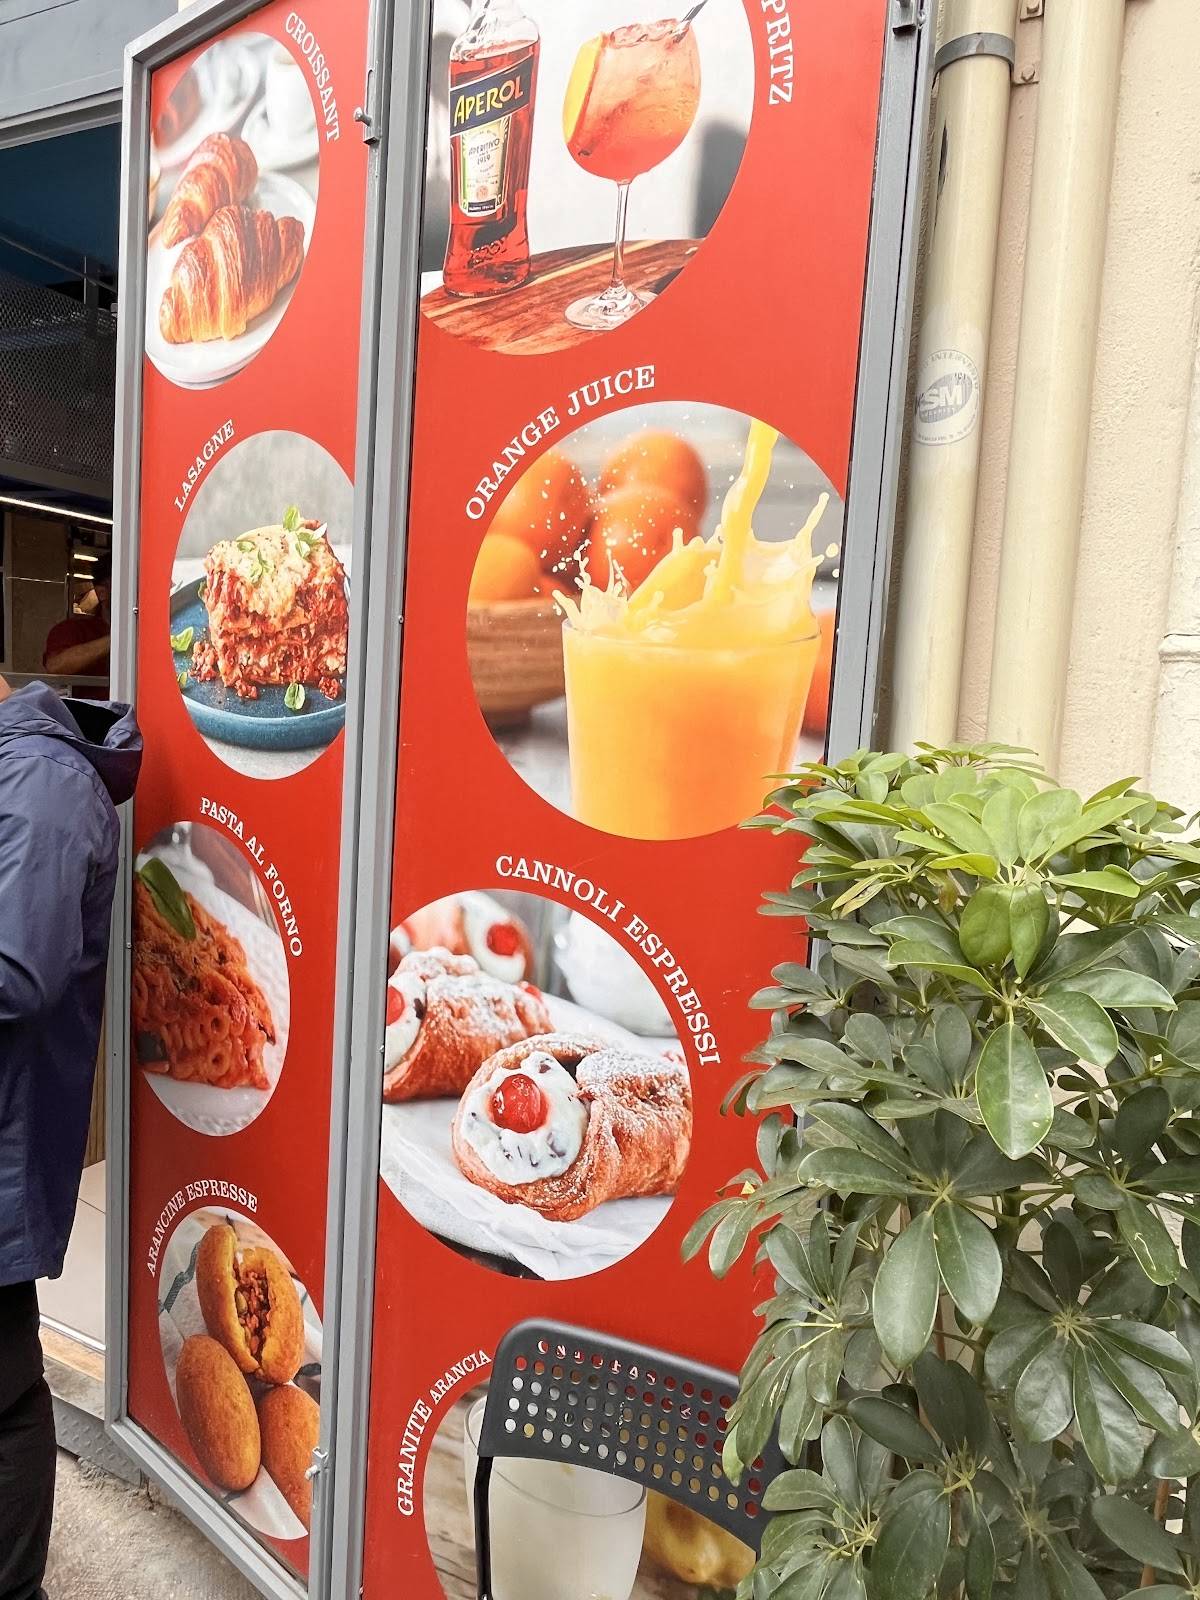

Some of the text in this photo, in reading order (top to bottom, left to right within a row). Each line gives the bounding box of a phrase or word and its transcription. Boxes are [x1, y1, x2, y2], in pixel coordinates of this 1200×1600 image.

[285, 12, 340, 142] CROISSANT
[453, 76, 524, 127] APEROL
[174, 419, 235, 512] LASAGNE
[465, 365, 655, 520] ORANGE JUICE
[200, 797, 303, 957] PASTA AL FORNO
[495, 855, 721, 1066] CANNOLI ESPRESSI
[146, 1179, 258, 1278] ARANCINE ESPRESSE
[397, 1350, 492, 1516] GRANITE ARANCIA
